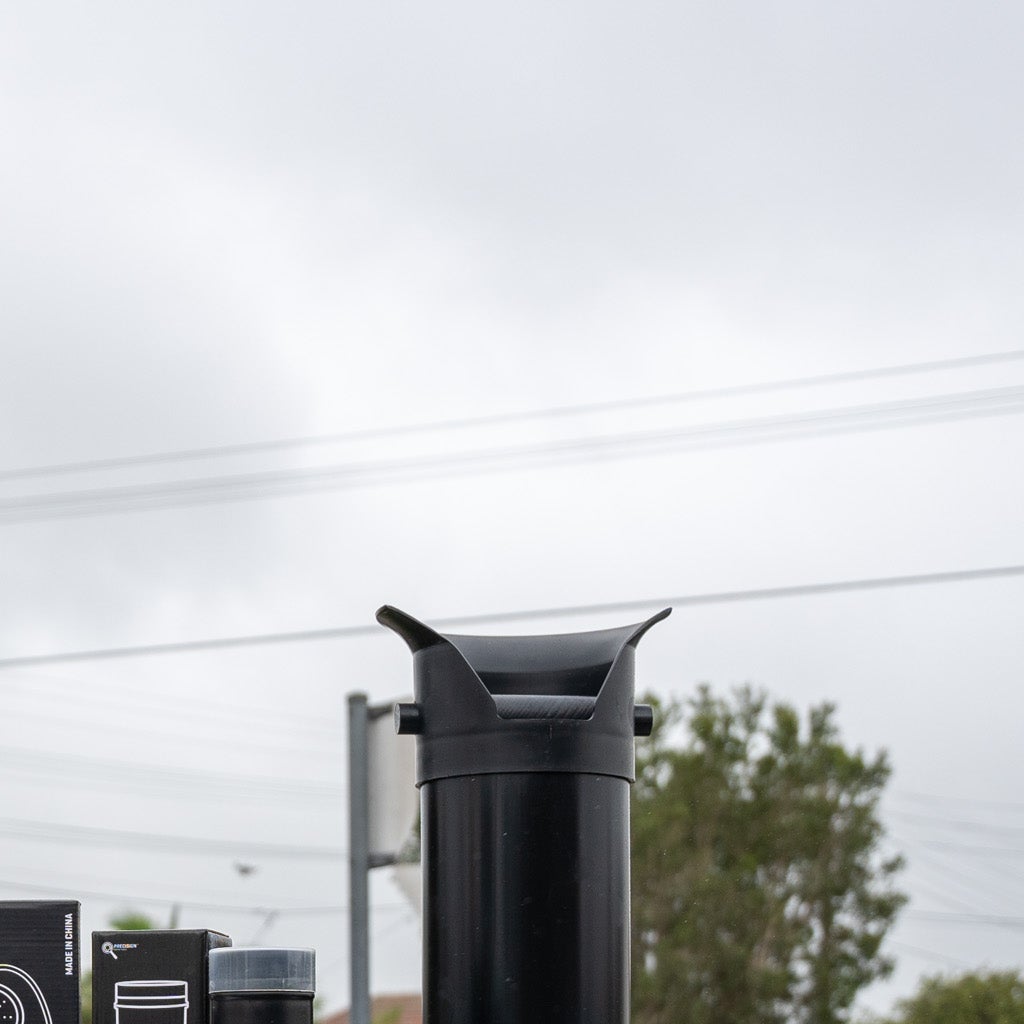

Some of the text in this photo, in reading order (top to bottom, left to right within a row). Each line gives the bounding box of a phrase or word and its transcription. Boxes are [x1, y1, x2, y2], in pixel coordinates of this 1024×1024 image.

[64, 913, 73, 975] MADE IN CHINA
